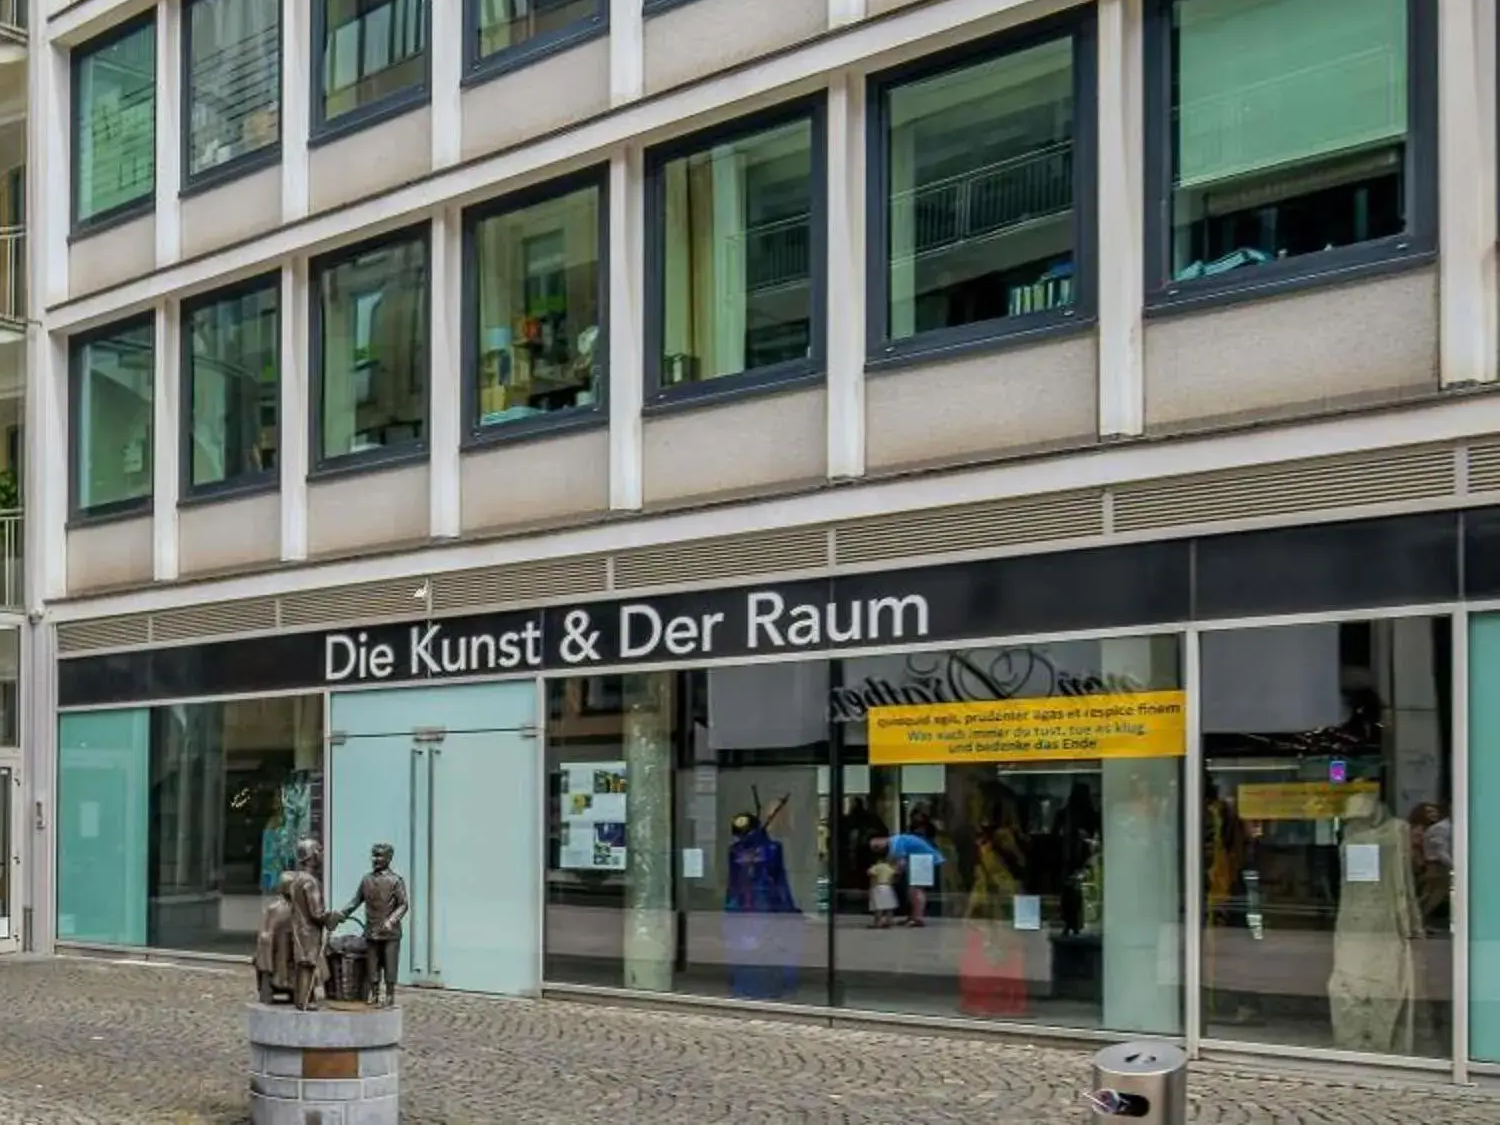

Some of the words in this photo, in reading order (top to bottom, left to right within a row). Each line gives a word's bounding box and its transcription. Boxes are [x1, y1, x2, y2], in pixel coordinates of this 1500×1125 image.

[325, 635, 395, 681] Die
[409, 621, 542, 675] Kunst
[559, 609, 601, 665] &
[619, 605, 724, 659] Der
[746, 591, 929, 648] Raum
